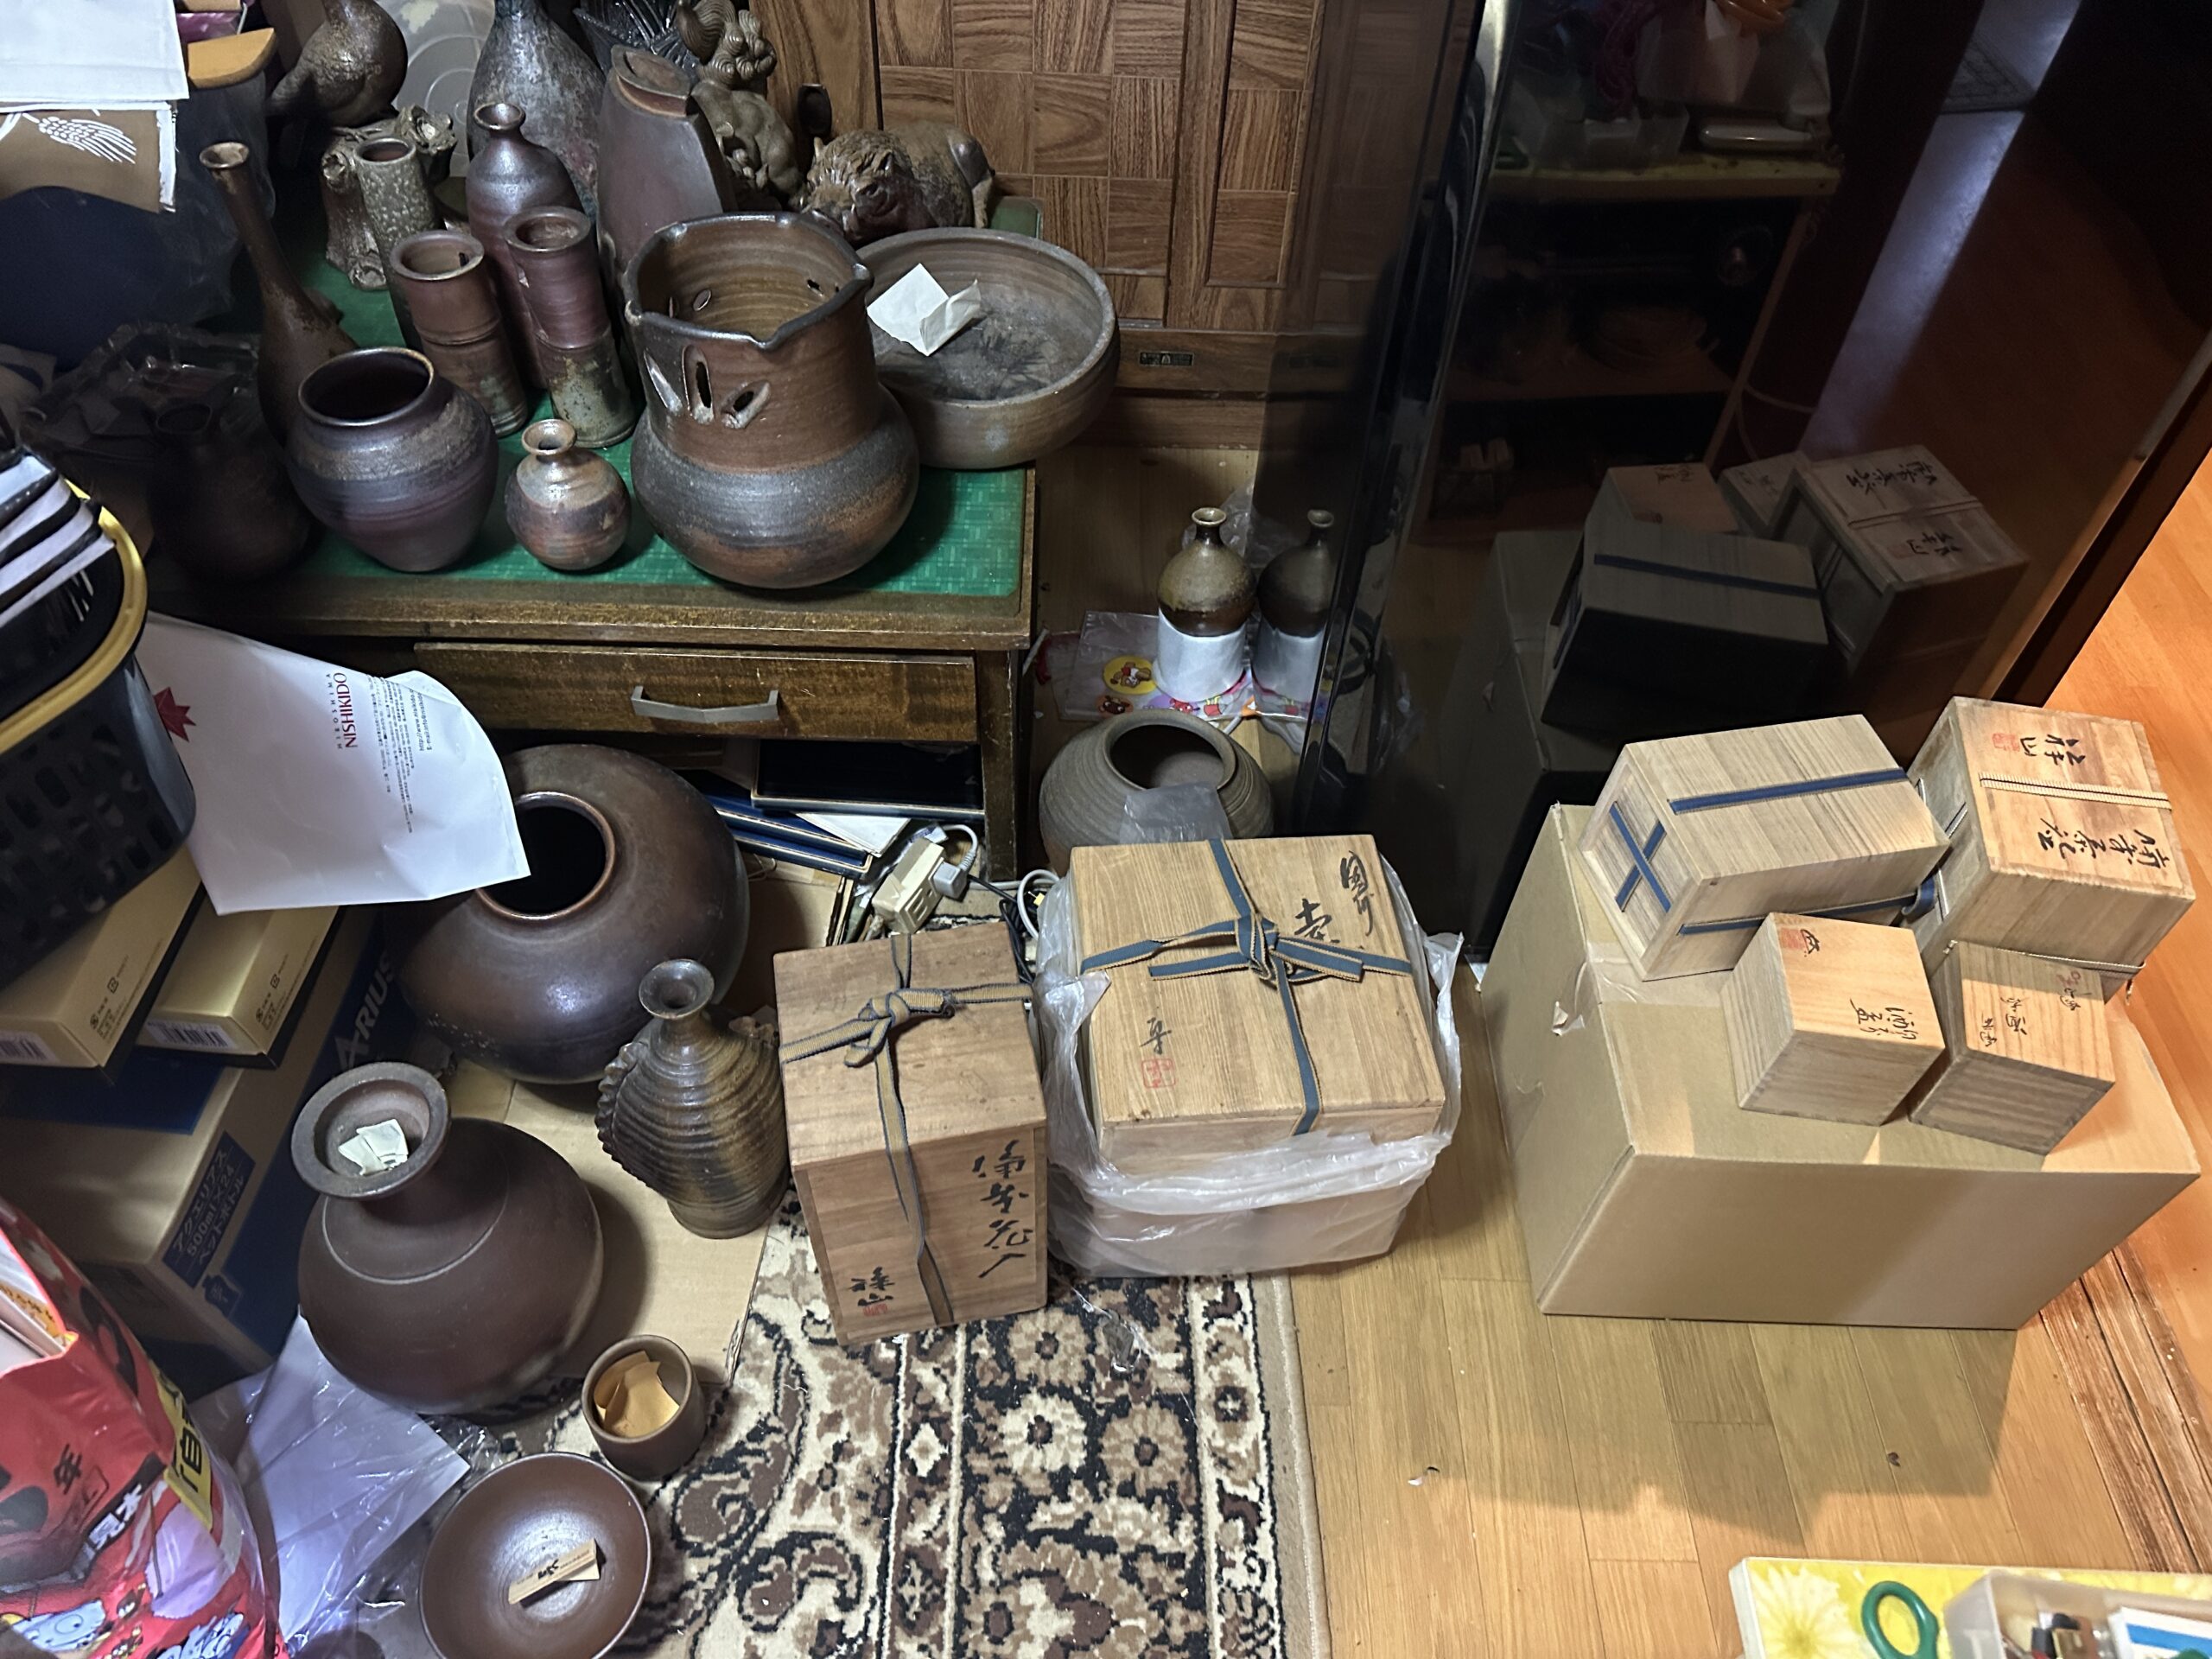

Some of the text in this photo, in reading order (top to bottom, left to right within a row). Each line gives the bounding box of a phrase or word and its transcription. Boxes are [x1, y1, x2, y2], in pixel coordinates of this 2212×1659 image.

[326, 673, 343, 750] HIROSHIMA
[334, 672, 359, 748] NISHIKIDO
[174, 1148, 226, 1252] アクエリアス
